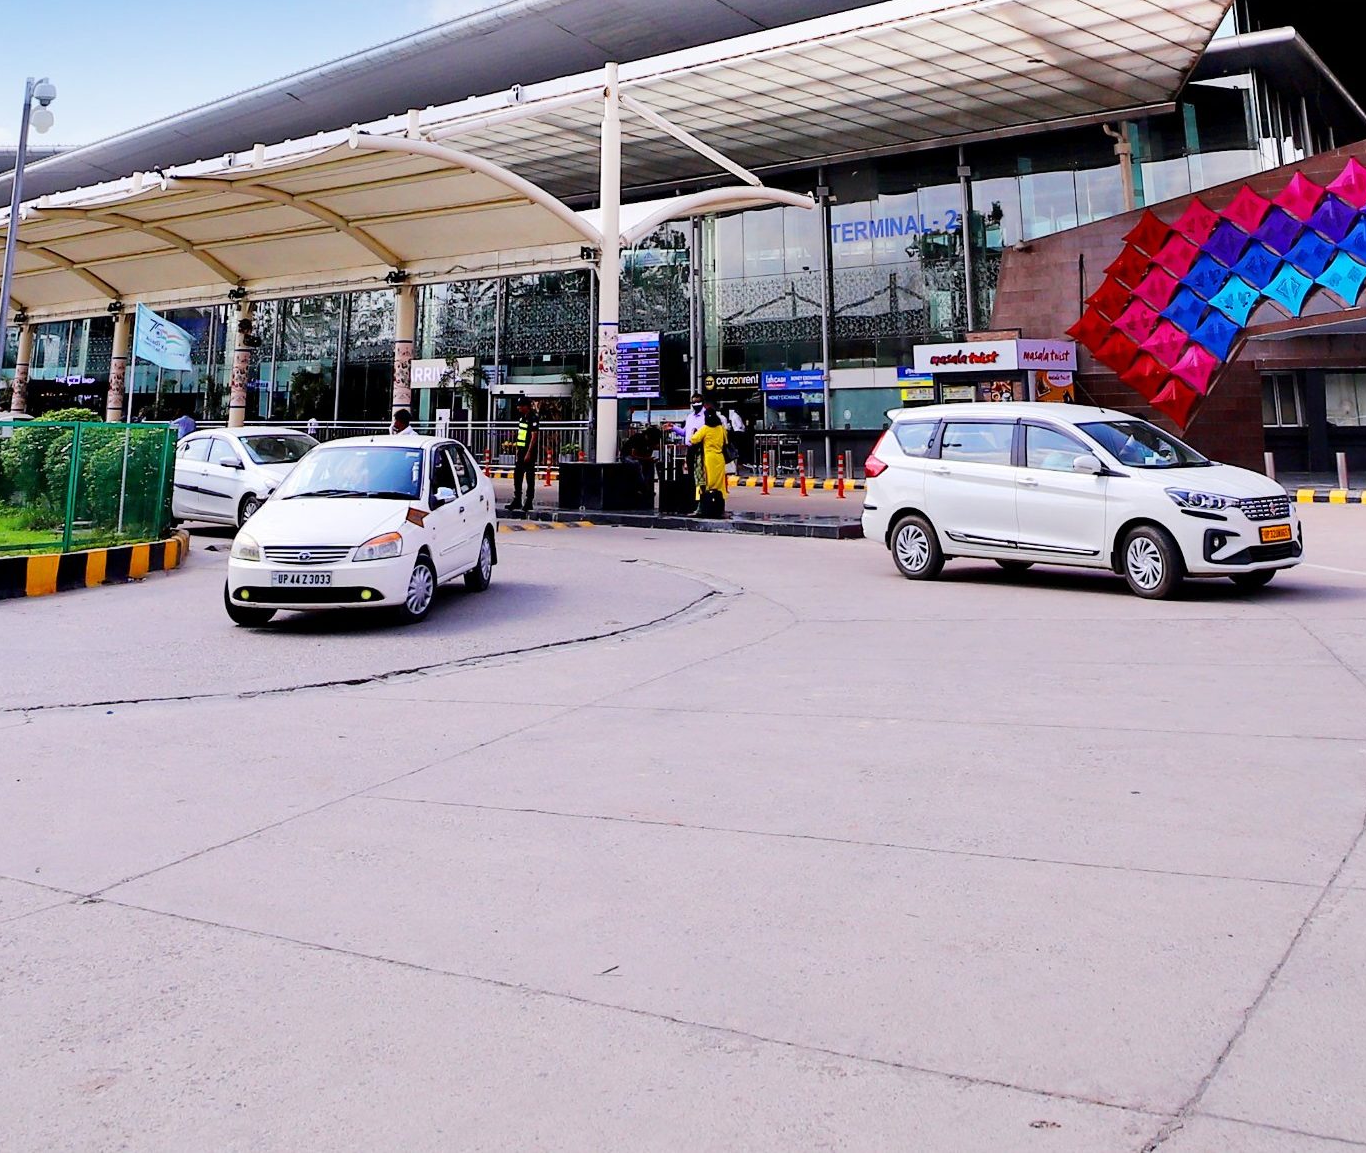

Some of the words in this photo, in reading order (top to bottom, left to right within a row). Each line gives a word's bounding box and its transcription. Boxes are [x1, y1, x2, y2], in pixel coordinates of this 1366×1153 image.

[945, 209, 957, 230] 2
[1023, 347, 1049, 362] masala
[1050, 349, 1070, 362] twist
[716, 374, 759, 385] carzonrent
[278, 574, 289, 584] UP
[290, 574, 300, 584] 44
[302, 574, 308, 584] Z
[309, 574, 331, 584] 3033
